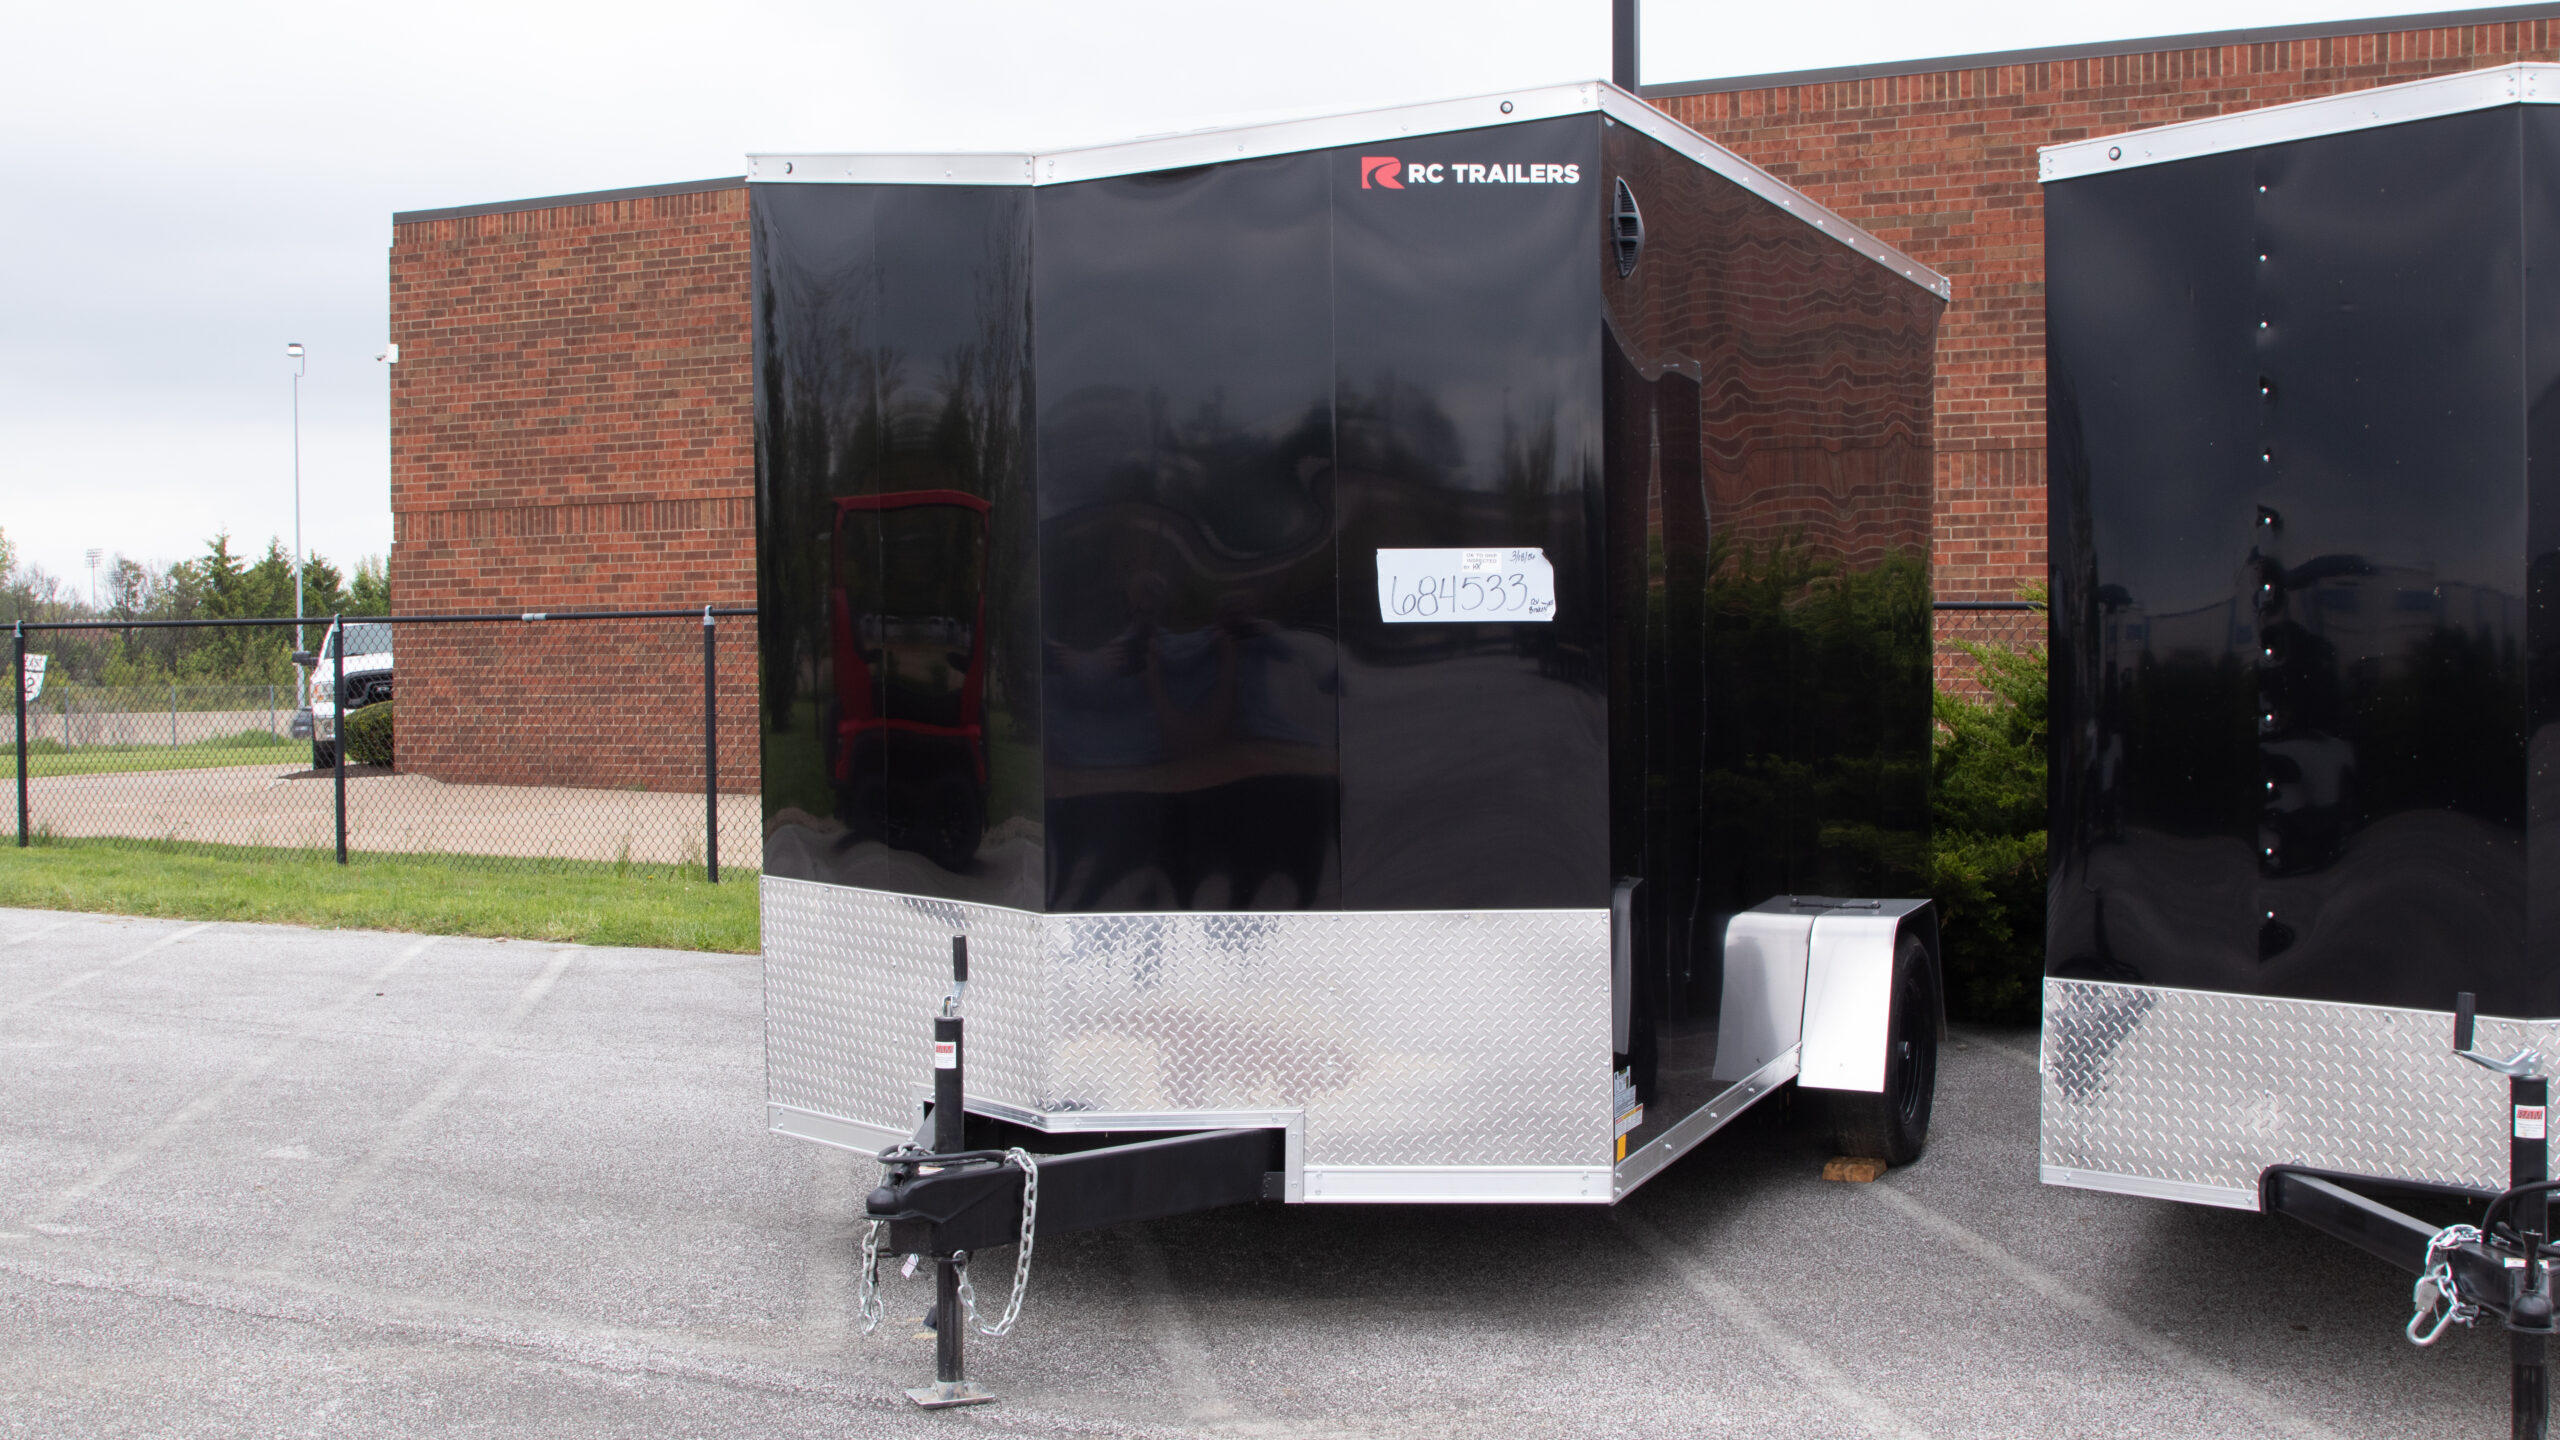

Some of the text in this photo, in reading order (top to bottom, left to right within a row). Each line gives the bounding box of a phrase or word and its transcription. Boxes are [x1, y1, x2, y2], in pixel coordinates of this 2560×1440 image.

[1408, 163, 1580, 184] RC TRAILERS
[1391, 573, 1528, 616] 684533
